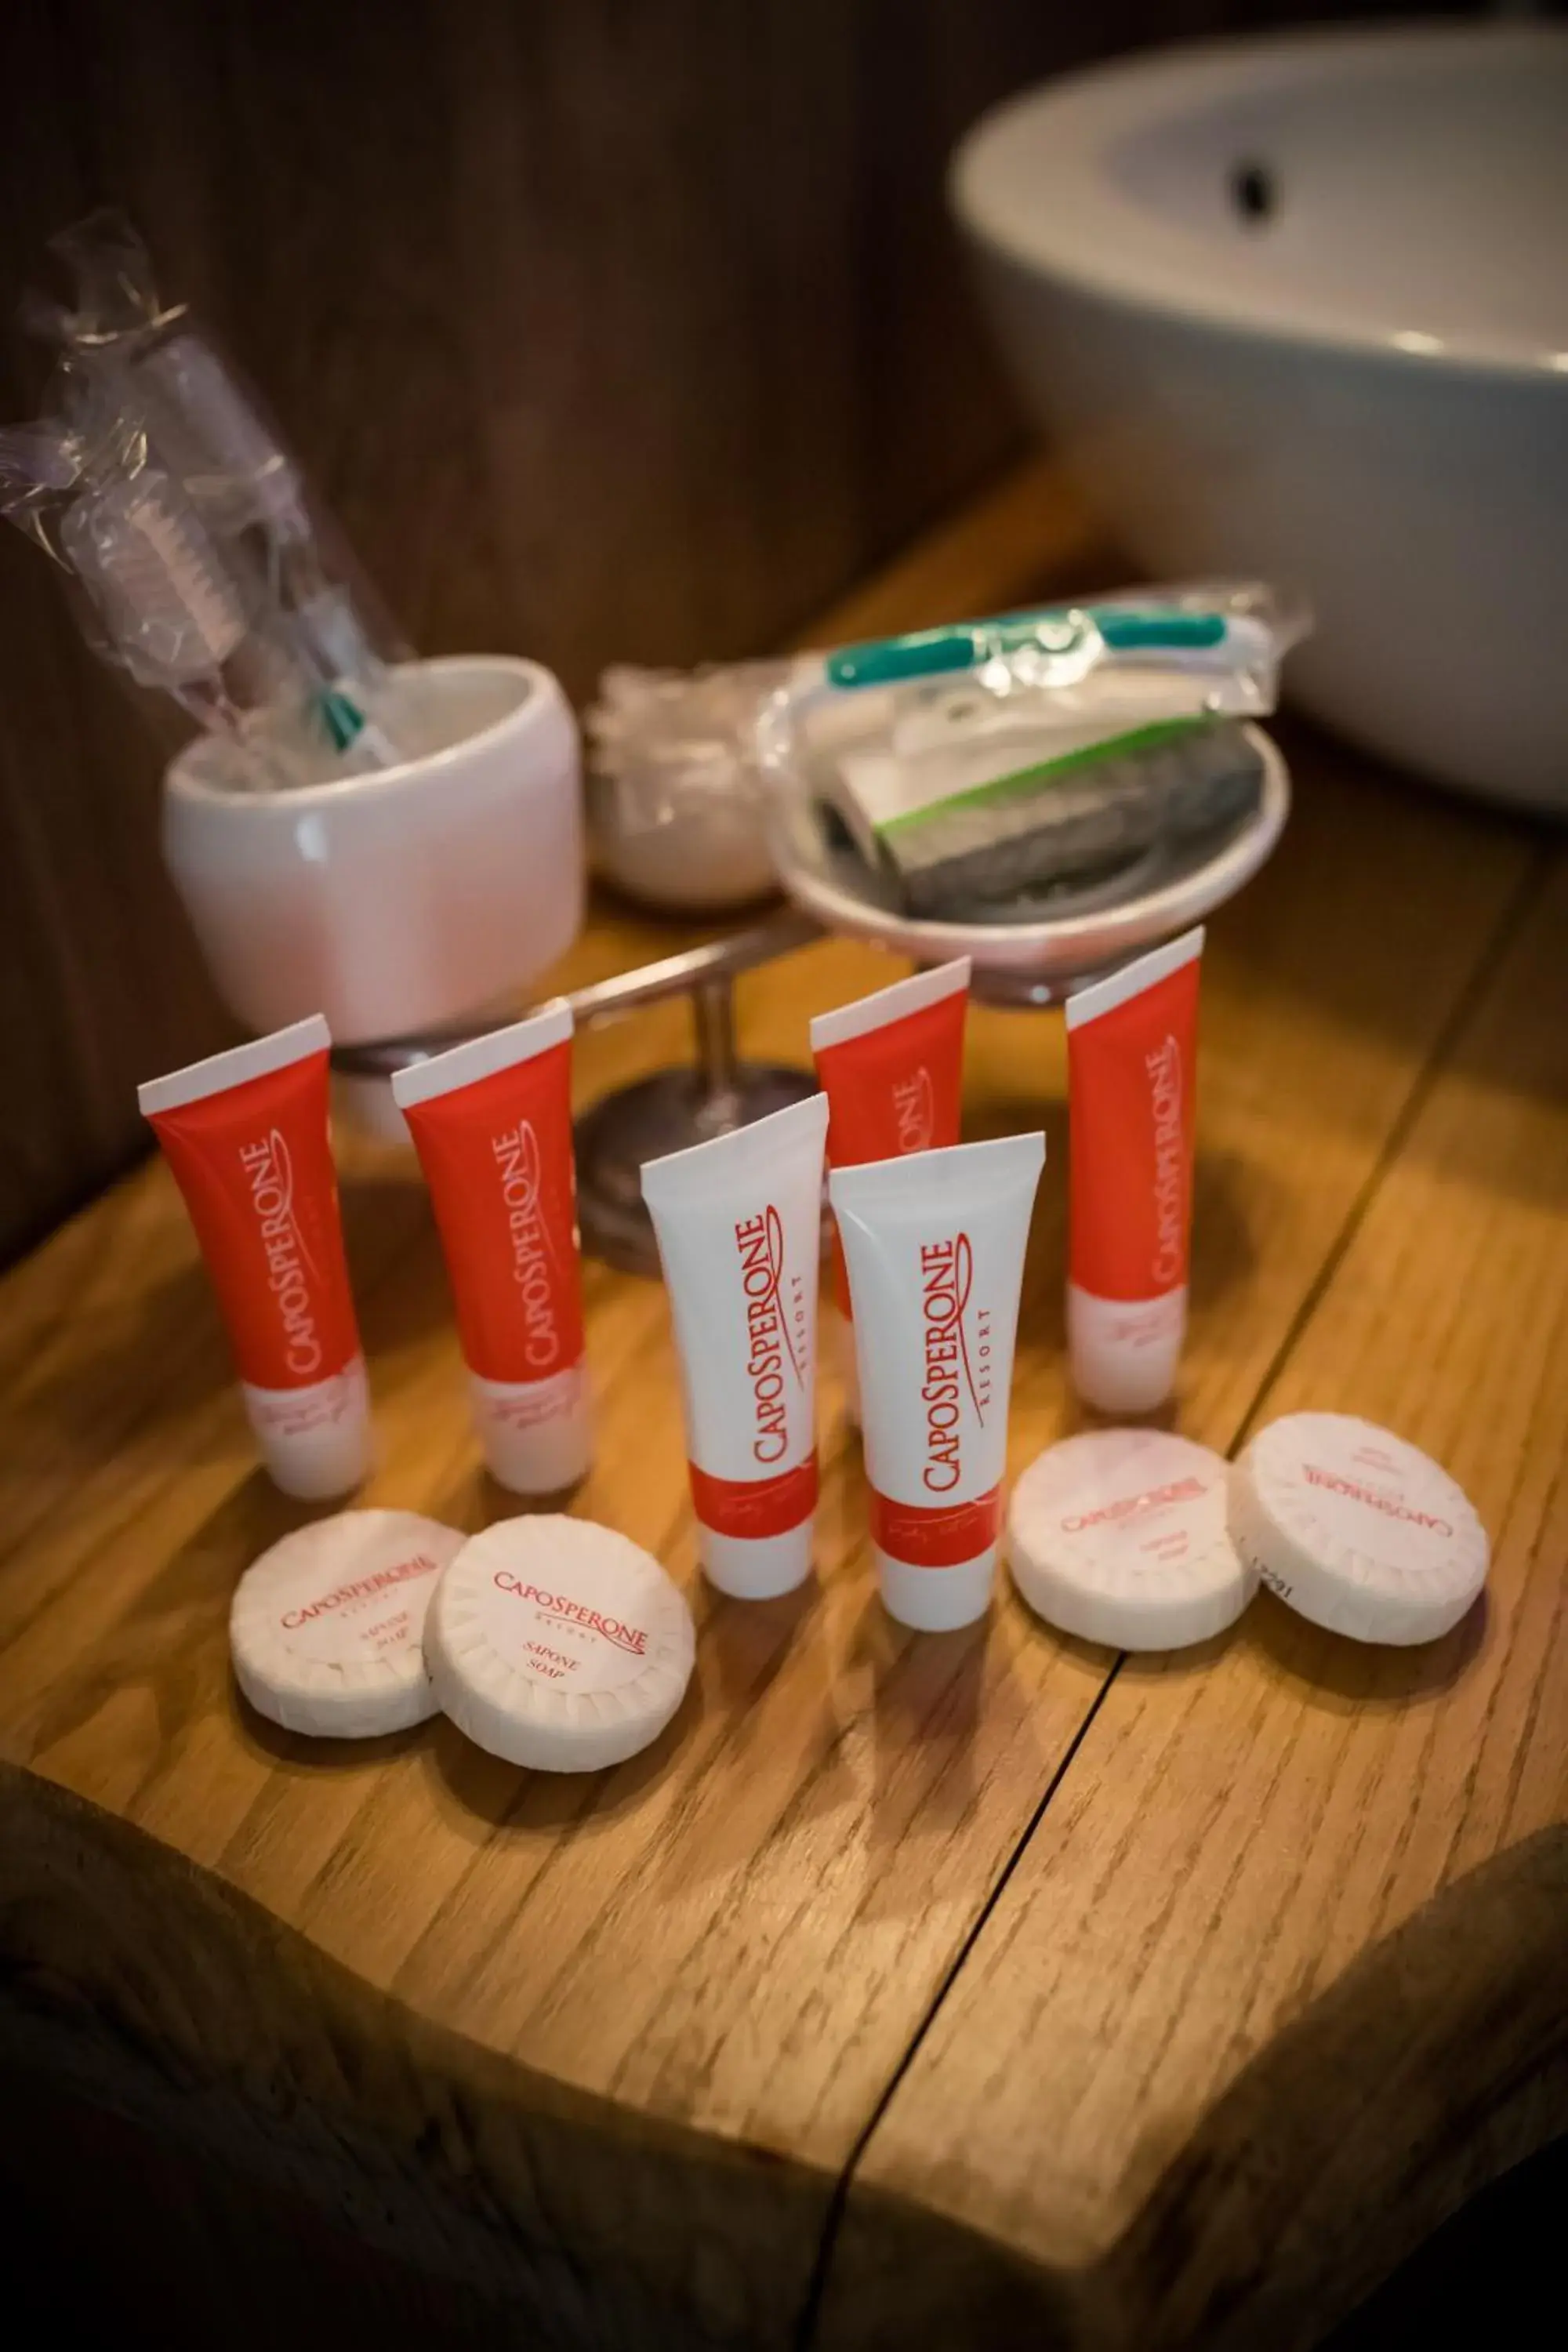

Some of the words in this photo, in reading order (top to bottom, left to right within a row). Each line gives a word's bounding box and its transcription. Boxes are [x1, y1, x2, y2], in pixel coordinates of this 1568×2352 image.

[238, 1137, 322, 1374] CAPOSPERONE
[492, 1126, 559, 1367] CAPOSPERONE
[735, 1214, 789, 1463] CAPOSPERONE
[920, 1240, 960, 1493] CAPOSPERONE
[978, 1308, 991, 1407] RESORT
[493, 1570, 649, 1648] CAPOSPERONE
[522, 1640, 582, 1671] SAPONE
[526, 1658, 565, 1679] SOAP
